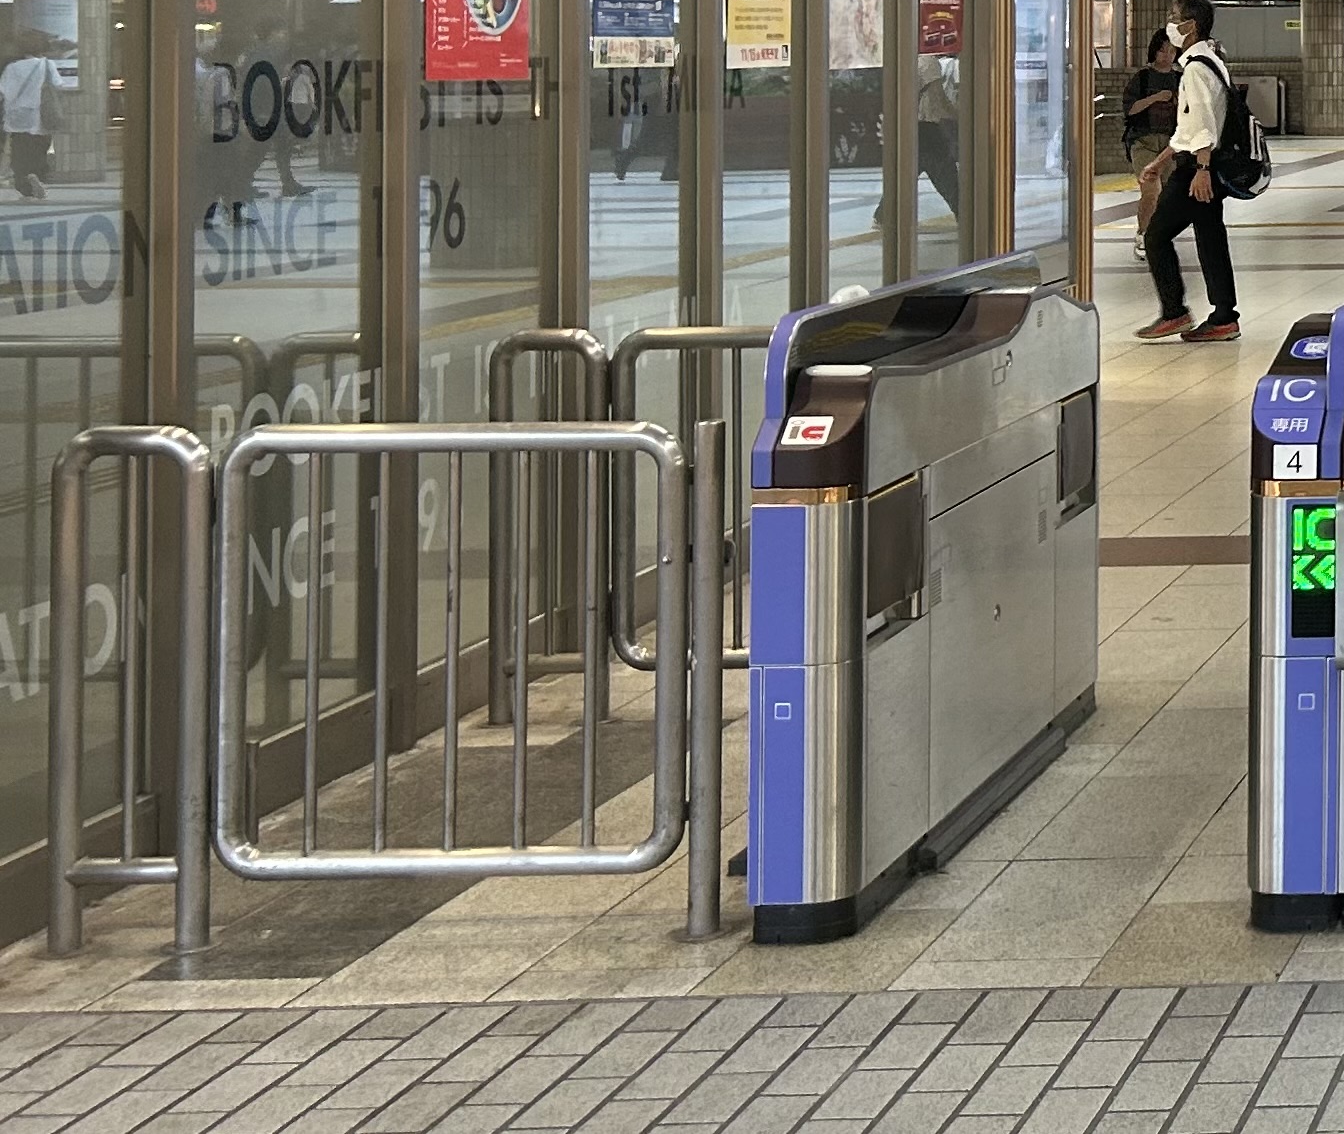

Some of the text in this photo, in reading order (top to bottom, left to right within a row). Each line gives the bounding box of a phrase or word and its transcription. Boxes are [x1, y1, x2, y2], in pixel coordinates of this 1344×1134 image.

[203, 191, 337, 286] SINCE
[1270, 378, 1317, 402] IC
[1271, 417, 1308, 432] 専用
[1287, 451, 1302, 473] 4
[1293, 508, 1335, 550] IC
